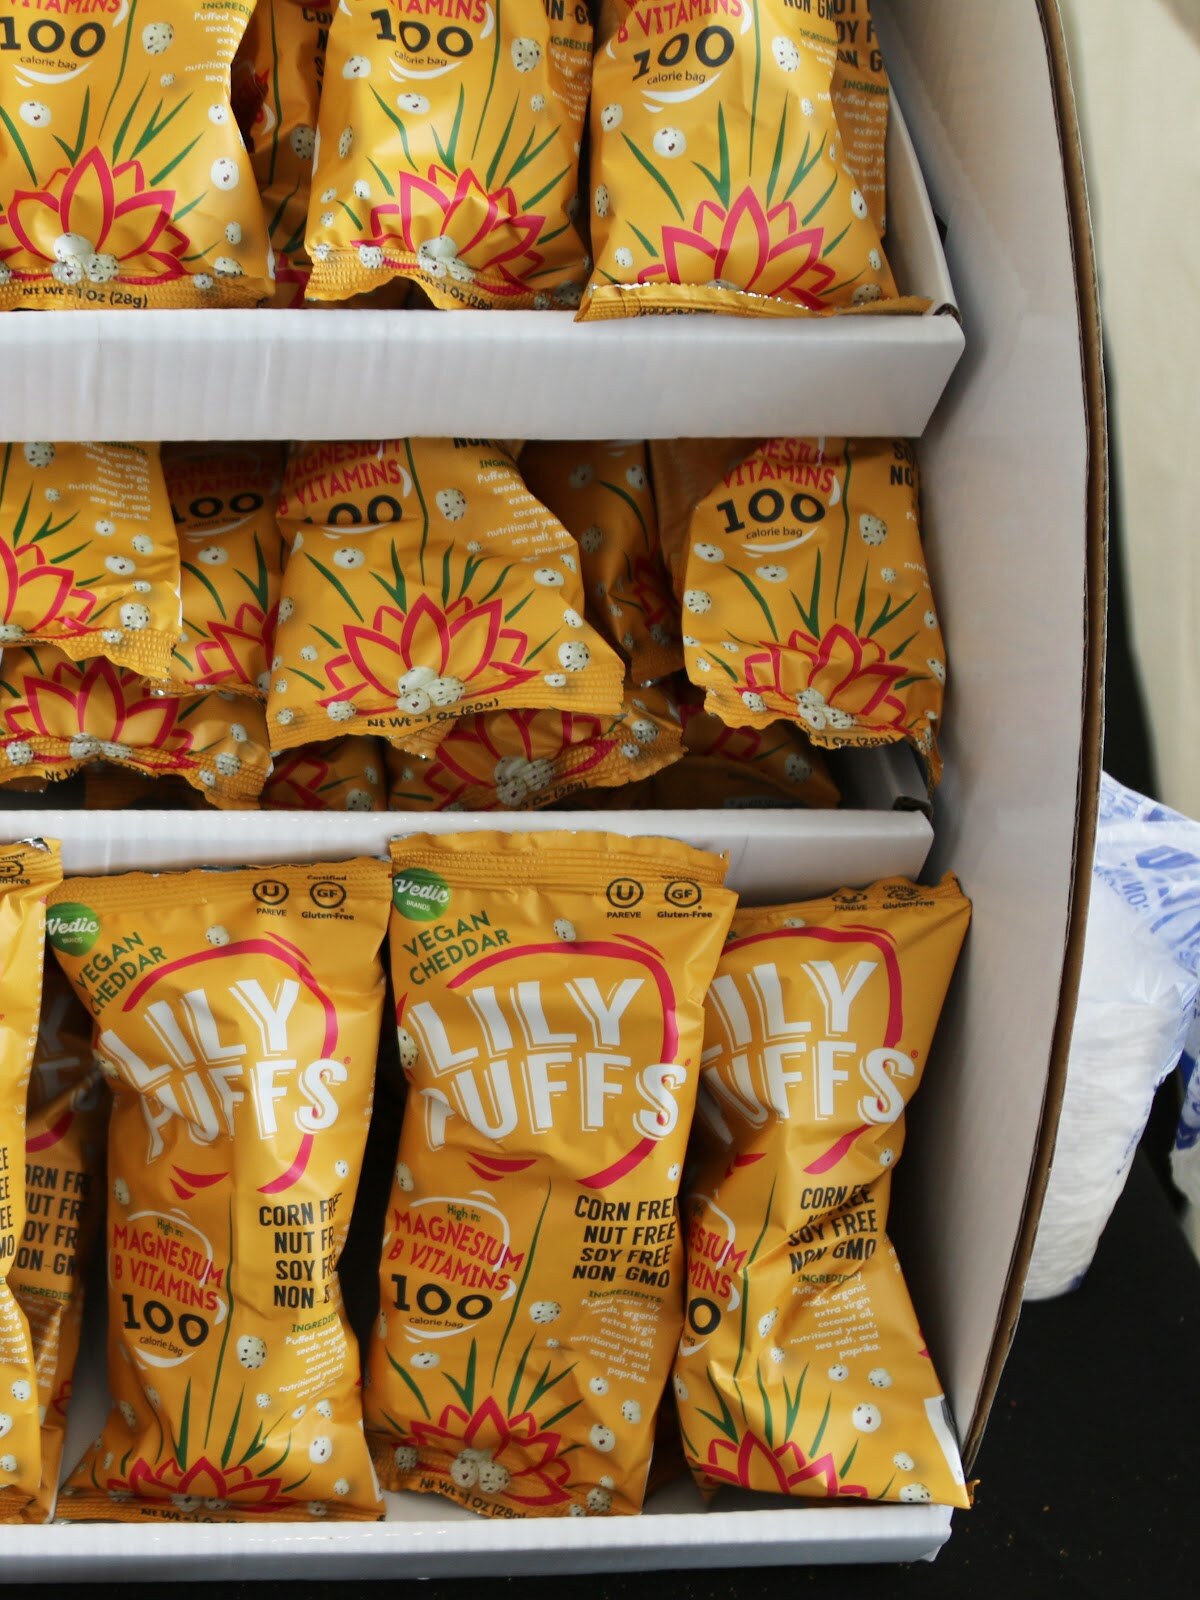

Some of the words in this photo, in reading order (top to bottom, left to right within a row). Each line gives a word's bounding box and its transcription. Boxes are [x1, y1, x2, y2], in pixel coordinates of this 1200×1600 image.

[635, 0, 742, 36] VITAMINS
[370, 9, 473, 57] 100
[20, 56, 55, 67] calorie
[58, 58, 77, 70] bag
[394, 50, 424, 65] calorie
[427, 56, 448, 67] bag
[632, 25, 735, 81] 100
[647, 73, 683, 85] calorie
[685, 70, 706, 83] bag
[85, 289, 106, 302] Oz
[109, 291, 148, 308] (28g)
[294, 459, 401, 506] VITAMINS
[721, 460, 835, 493] VITAMINS
[716, 488, 826, 534] 100
[746, 528, 780, 540] calorie
[783, 527, 803, 538] bag
[367, 718, 386, 728] Nt
[389, 717, 412, 728] Wt
[262, 885, 280, 898] U
[316, 888, 339, 899] GF
[394, 878, 449, 906] Vedic
[615, 885, 633, 900] U
[671, 888, 693, 899] GF
[256, 907, 287, 917] PAREVE
[301, 911, 354, 921] Gluten-Free
[406, 899, 431, 912] BRANDS
[606, 910, 642, 919] PAREVE
[657, 910, 713, 919] Gluten-Free
[882, 900, 935, 909] Gluten-Free
[46, 916, 100, 935] Vedic
[402, 910, 492, 958] VEGAN
[75, 930, 144, 991] VEGAN
[408, 928, 512, 986] CHEDDAR
[90, 946, 168, 1016] CHEDDAR
[706, 959, 879, 1054] ILY
[99, 979, 300, 1092] LILY
[407, 977, 645, 1079] LILY
[141, 1058, 348, 1165] PUFFS
[574, 1194, 630, 1222] CORN
[800, 1186, 848, 1210] CORN
[259, 1201, 315, 1227] CORN
[446, 1203, 469, 1222] High
[831, 1209, 878, 1238] FREE
[156, 1218, 173, 1236] High
[584, 1226, 628, 1246] NUT
[632, 1223, 676, 1246] FREE
[274, 1232, 315, 1254] NUT
[393, 1208, 525, 1272] MAGNESIUM
[113, 1224, 224, 1289] MAGNESIUM
[388, 1239, 403, 1260] B
[409, 1242, 513, 1292] VITAMINS
[580, 1247, 622, 1262] SOY
[627, 1244, 671, 1268] FREE
[276, 1260, 315, 1281] SOY
[114, 1255, 123, 1281] B
[130, 1257, 219, 1311] VITAMINS
[391, 1272, 493, 1320] 100
[844, 1296, 871, 1311] virgin
[121, 1294, 209, 1347] 100
[409, 1316, 443, 1328] calorie
[445, 1320, 464, 1329] bag
[630, 1320, 656, 1335] virgin
[817, 1314, 856, 1329] coconut
[139, 1334, 167, 1352] calorie
[168, 1342, 184, 1358] bag
[859, 1331, 879, 1341] and
[631, 1359, 650, 1372] and
[419, 1477, 435, 1490] Nt
[439, 1481, 458, 1496] Wt
[472, 1497, 489, 1512] Oz
